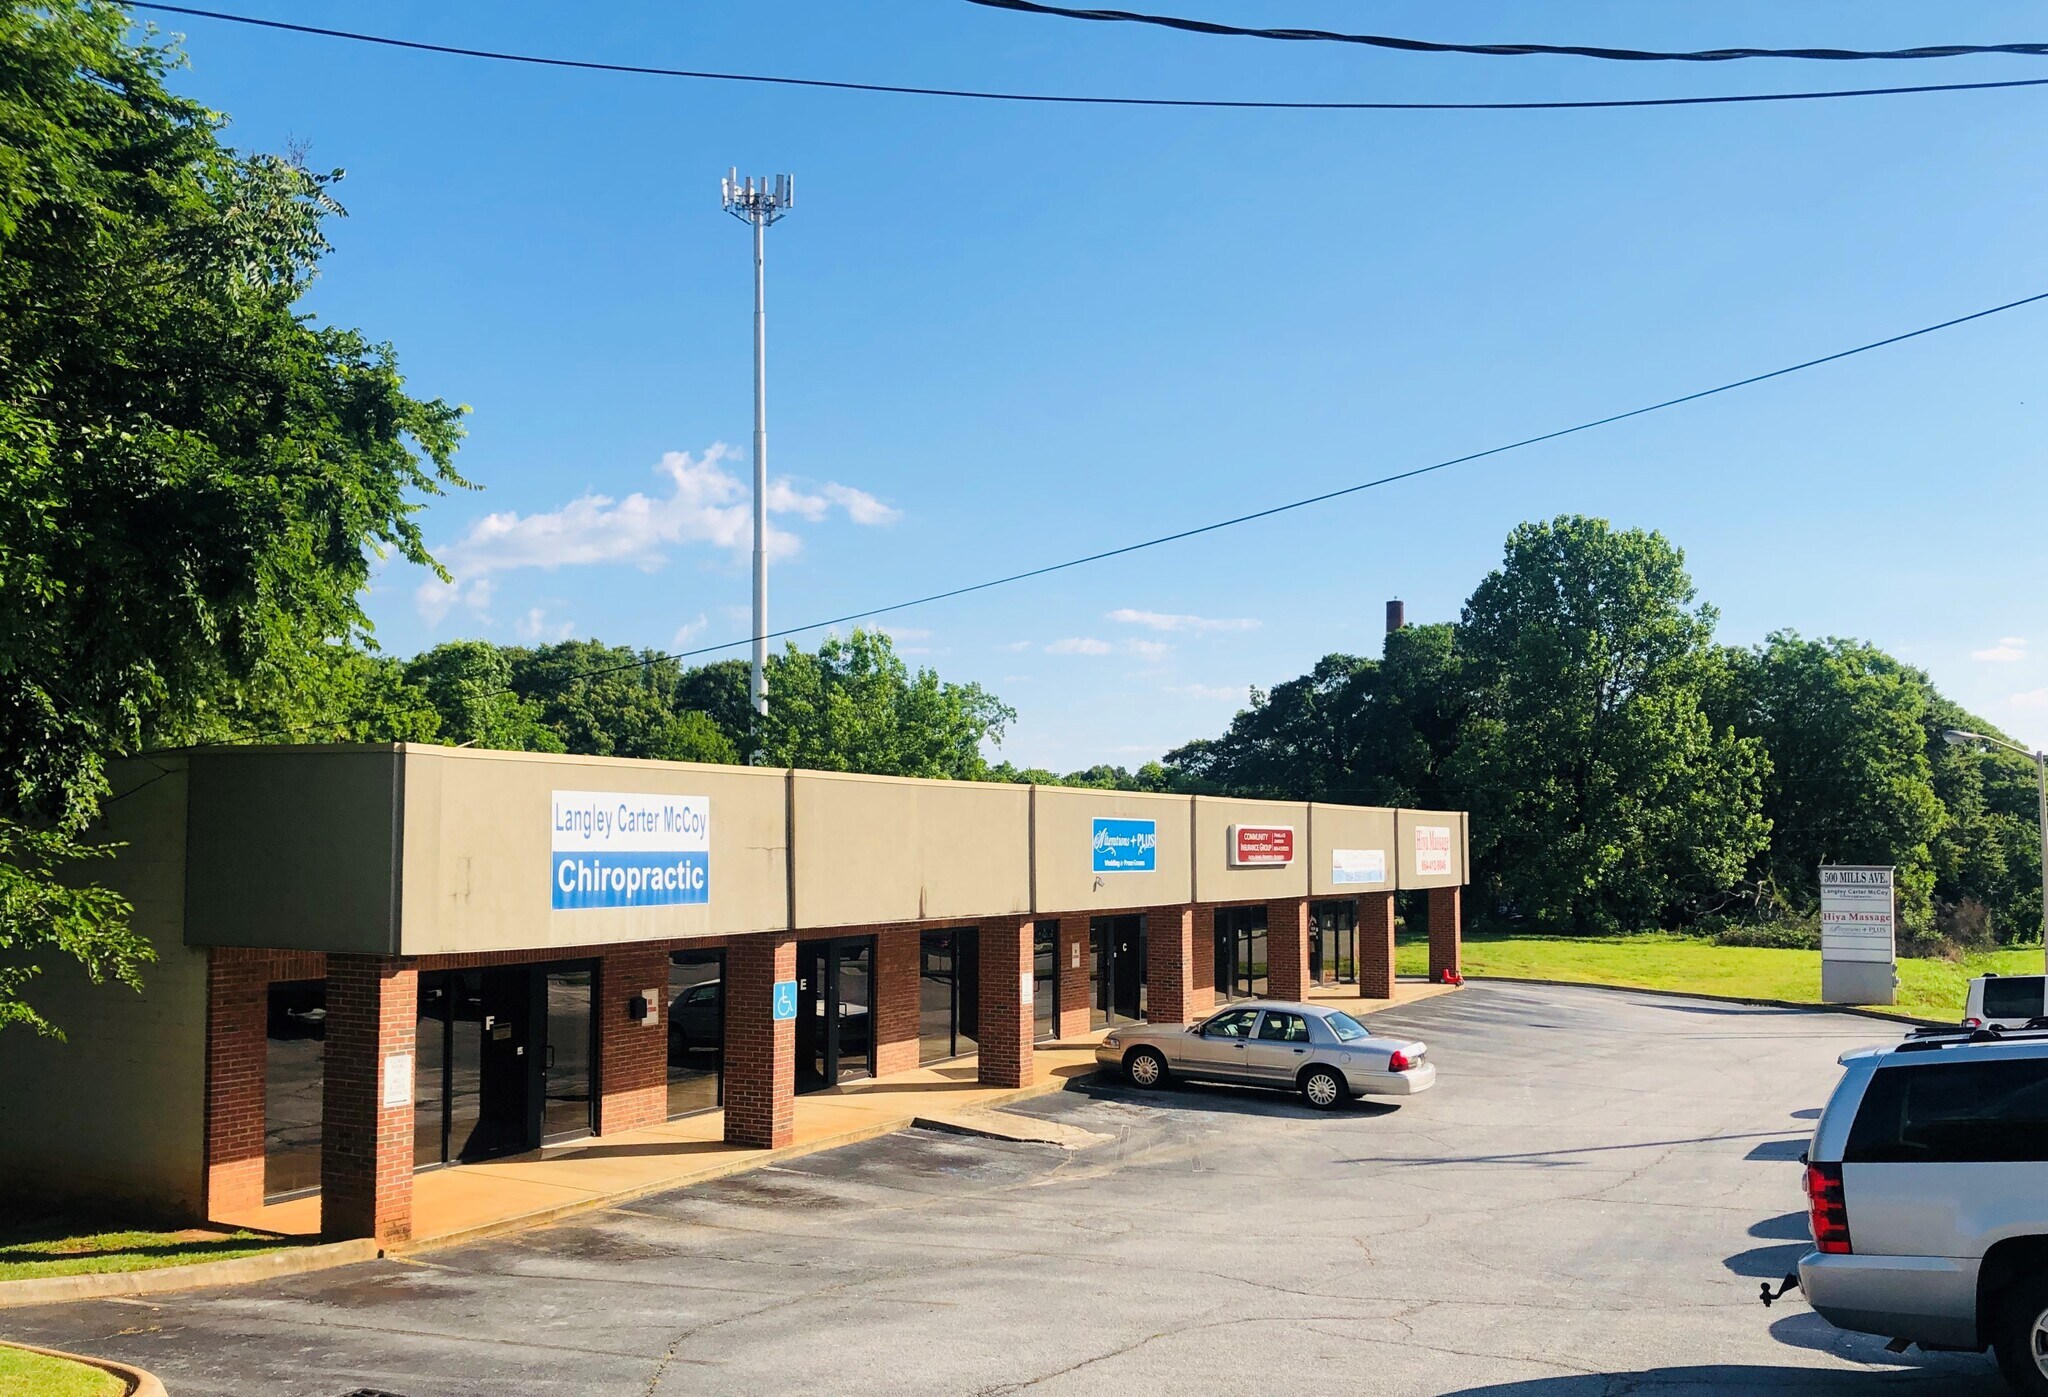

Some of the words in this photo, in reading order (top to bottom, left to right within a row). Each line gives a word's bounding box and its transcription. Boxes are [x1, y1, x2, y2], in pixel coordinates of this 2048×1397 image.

[556, 803, 613, 840] Langley
[618, 804, 660, 833] Carter
[664, 806, 707, 840] McCoy
[1094, 828, 1130, 852] Alterations
[1137, 833, 1155, 850] PLUS
[1244, 832, 1269, 841] COMMUNITY
[558, 859, 705, 899] Chiropractic
[1824, 872, 1838, 882] 500
[1840, 872, 1867, 883] MILLS
[1868, 872, 1888, 884] AVE.
[1823, 913, 1846, 922] Hiya
[1849, 913, 1891, 923] Massage
[800, 978, 807, 991] E
[486, 1015, 495, 1031] F
